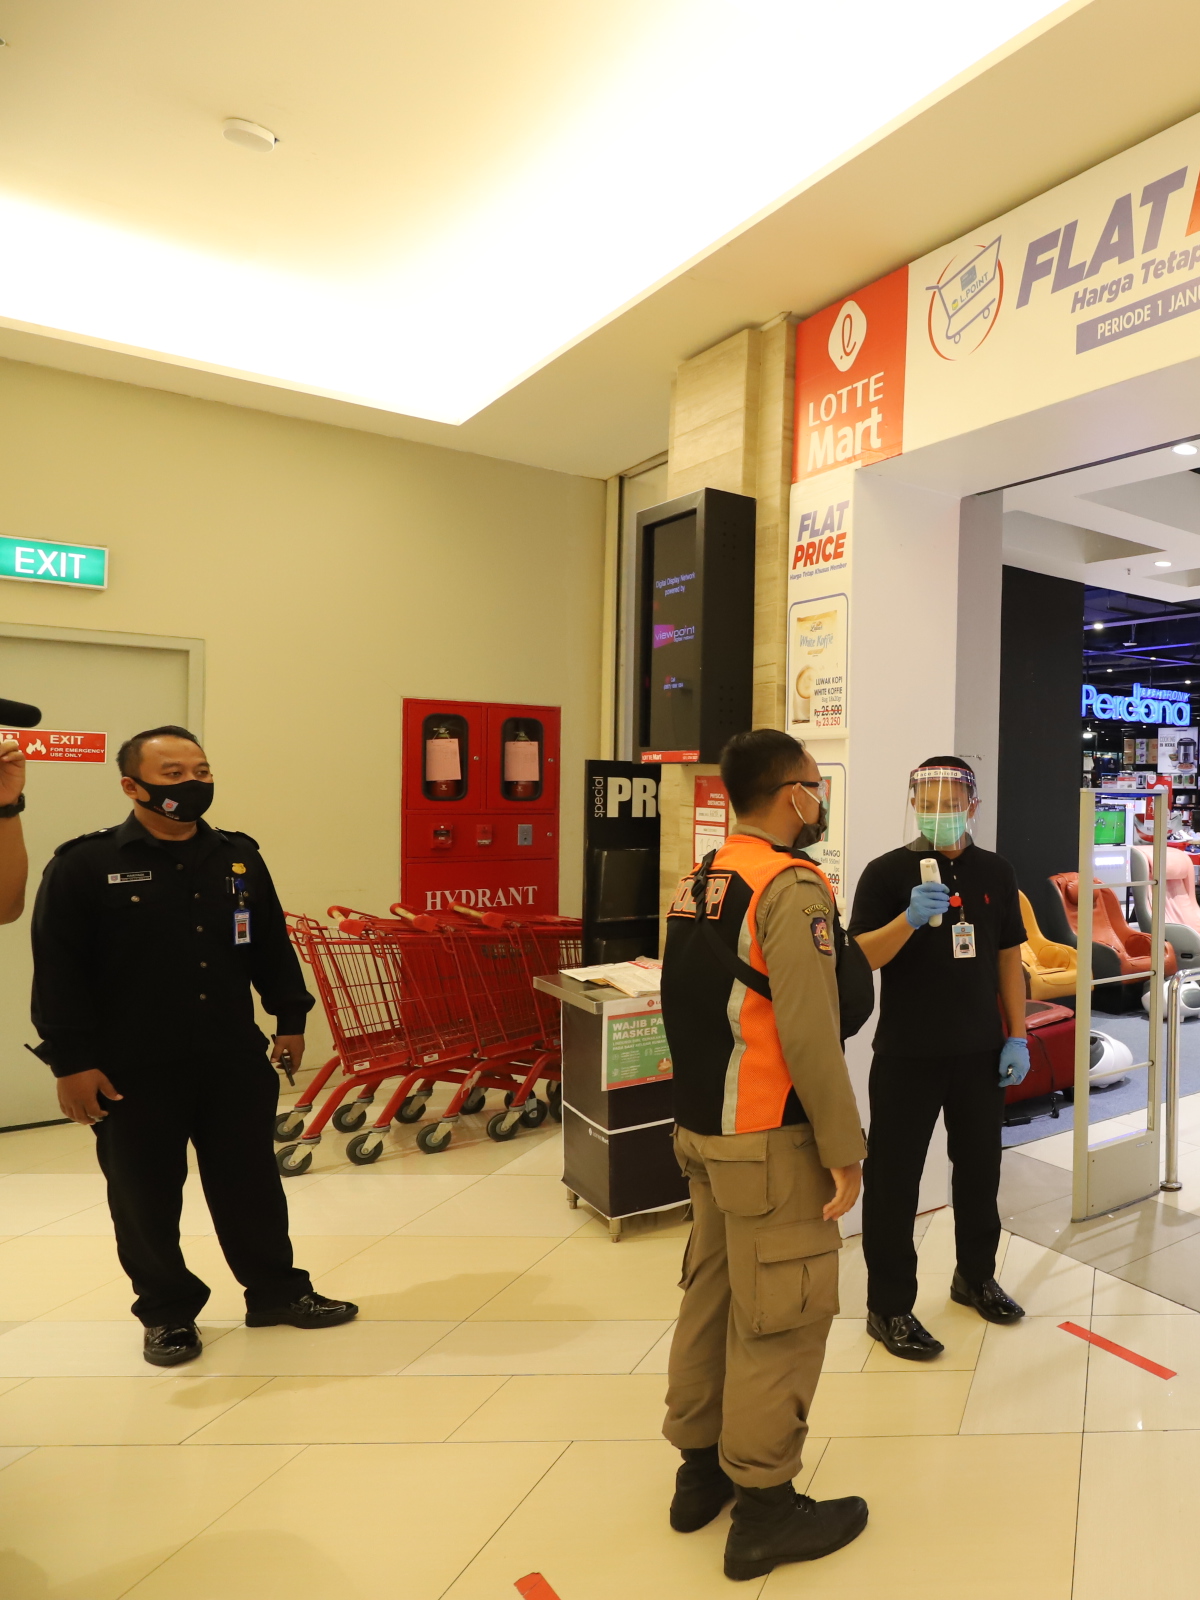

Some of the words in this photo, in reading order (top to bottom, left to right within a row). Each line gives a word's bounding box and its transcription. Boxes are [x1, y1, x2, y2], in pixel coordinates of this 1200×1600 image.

[1016, 165, 1187, 309] FLAT
[960, 272, 988, 303] L.POINT
[1070, 272, 1134, 314] Harga
[1097, 304, 1151, 339] PERIODE
[1157, 300, 1162, 316] 1
[809, 372, 884, 427] LOTTE
[807, 407, 882, 472] Mart
[797, 500, 849, 542] FLAT
[14, 547, 86, 579] EXIT
[792, 532, 847, 570] PRICE
[667, 576, 679, 586] Display
[681, 572, 695, 582] Network
[655, 625, 695, 641] viewpoint
[814, 688, 827, 696] WHITE
[828, 687, 842, 695] KOFFIE
[816, 677, 831, 685] LUWAK
[822, 717, 840, 726] 23.250
[50, 735, 84, 745] EXIT
[592, 776, 605, 818] special
[607, 777, 661, 818] PR
[823, 849, 840, 857] BANGO
[425, 886, 537, 911] HYDRANT
[613, 1020, 647, 1031] WAJIB
[613, 1027, 657, 1040] MASKER
